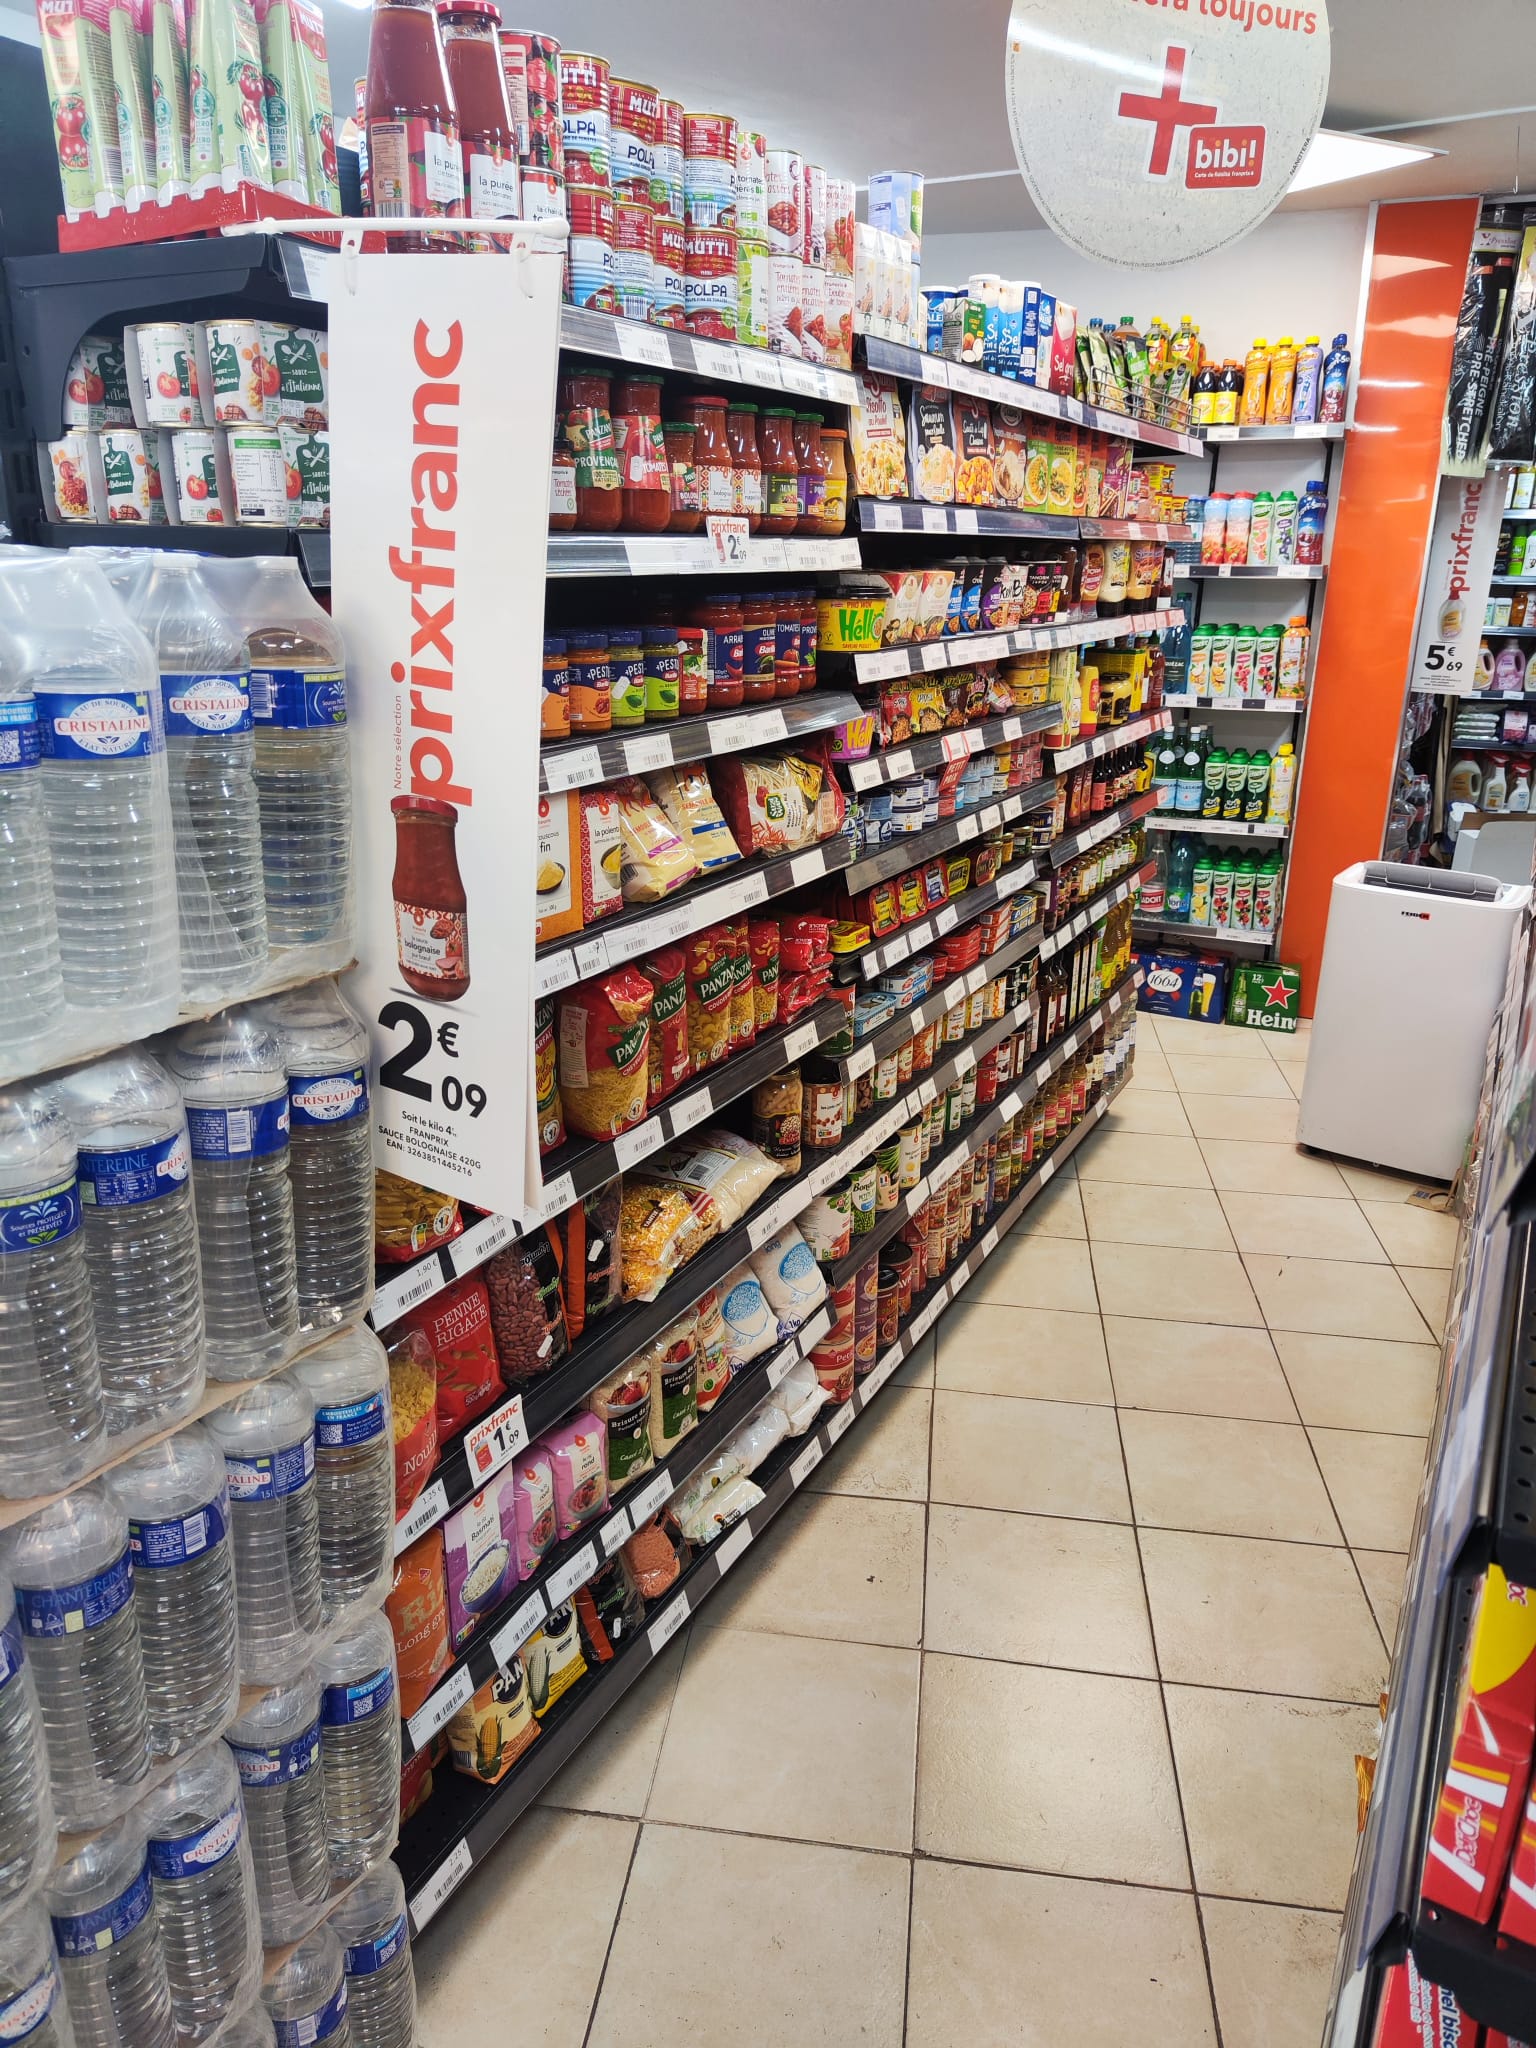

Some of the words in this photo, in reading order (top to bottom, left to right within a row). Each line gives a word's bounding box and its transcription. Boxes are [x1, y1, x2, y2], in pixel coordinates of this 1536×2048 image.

[561, 67, 597, 87] UTTI
[1195, 138, 1257, 169] bibi!
[479, 175, 488, 186] la
[490, 178, 514, 193] purée
[685, 236, 729, 257] MUTTI
[685, 283, 728, 298] POLPA
[585, 418, 613, 438] PANZAN
[711, 519, 747, 535] prixfranc
[1447, 482, 1484, 593] prixfranc
[728, 535, 739, 557] 2
[389, 318, 473, 806] prixfranc
[1424, 644, 1446, 671] 5
[1446, 661, 1464, 672] 69
[171, 695, 249, 712] CRISTALINE
[56, 715, 149, 734] CRISTALINE
[392, 694, 404, 757] sélection
[393, 760, 405, 791] Notre
[594, 828, 601, 837] la
[601, 825, 620, 838] polent
[540, 842, 551, 854] fin
[404, 939, 441, 955] bolognaise
[1150, 973, 1180, 989] 1664
[1252, 973, 1262, 981] 12
[437, 1021, 460, 1058] €
[378, 1001, 433, 1103] 2
[294, 1084, 363, 1107] CRISTALINE
[441, 1075, 488, 1119] 09
[401, 1110, 419, 1124] Soit
[419, 1116, 428, 1127] le
[428, 1117, 444, 1133] kilo
[378, 1125, 404, 1142] SAUCE
[405, 1136, 458, 1161] BOLOGNAISE
[459, 1156, 482, 1170] 420G
[409, 1126, 450, 1148] FRANPRIX
[82, 1153, 150, 1173] NTEREINE
[158, 1154, 186, 1176] CRIST
[386, 1138, 406, 1153] EAN:
[406, 1146, 474, 1178] 3263851445216
[9, 1221, 35, 1233] Sources
[18, 1230, 27, 1238] et
[432, 1291, 482, 1333] PENNE
[436, 1304, 488, 1348] RIGATE
[469, 1402, 519, 1451] prixfranc
[492, 1426, 506, 1452] 1
[509, 1429, 520, 1445] 09
[402, 1427, 438, 1476] Nouill
[581, 1459, 595, 1471] rond
[226, 1471, 271, 1485] TALINE
[470, 1516, 495, 1543] Basmati
[547, 1602, 573, 1628] AN
[240, 1760, 280, 1773] TALINE
